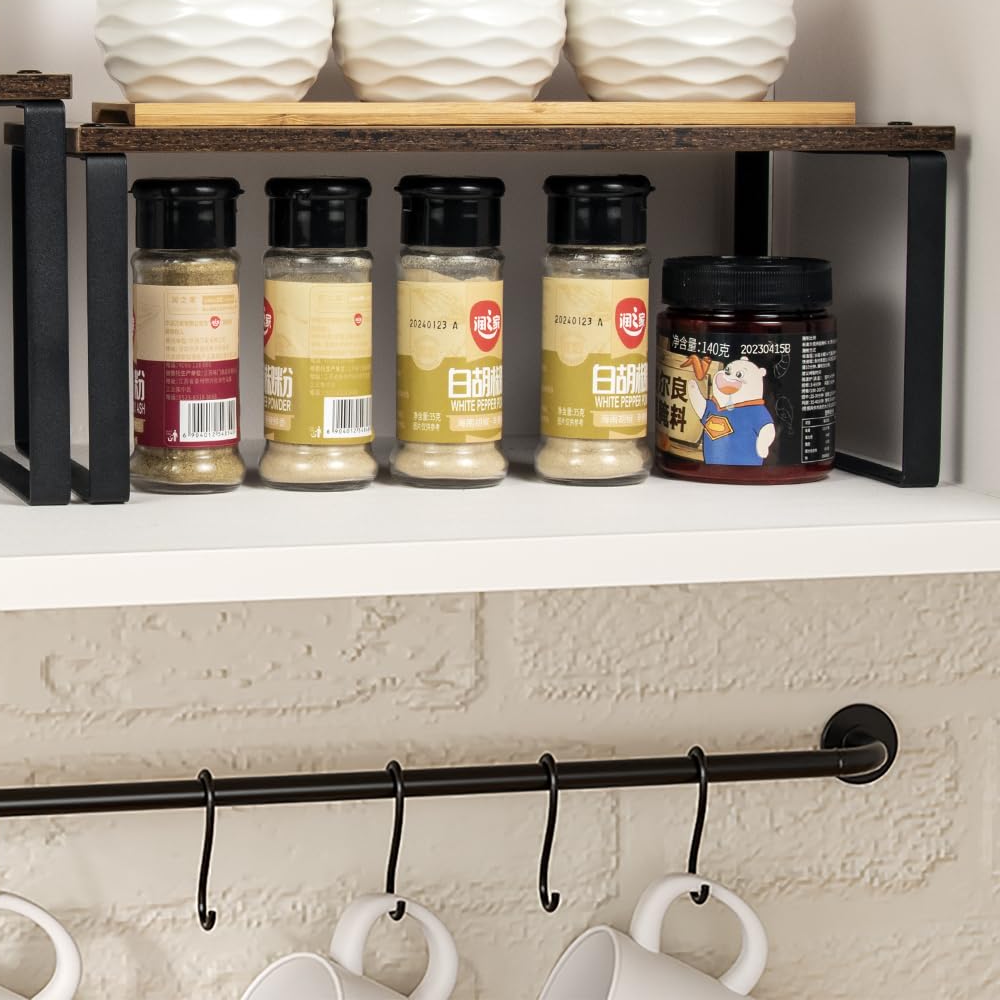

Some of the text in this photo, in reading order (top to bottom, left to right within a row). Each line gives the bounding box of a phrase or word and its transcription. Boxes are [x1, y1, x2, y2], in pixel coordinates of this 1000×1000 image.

[410, 319, 458, 330] 20240123 A
[554, 315, 592, 326] 20240123
[672, 334, 730, 358] 净含量:140克
[268, 398, 291, 411] POWDER
[451, 399, 476, 412] WHITE
[476, 398, 496, 411] PEPPER
[595, 395, 619, 408] WHITE
[620, 395, 641, 408] PEPPER
